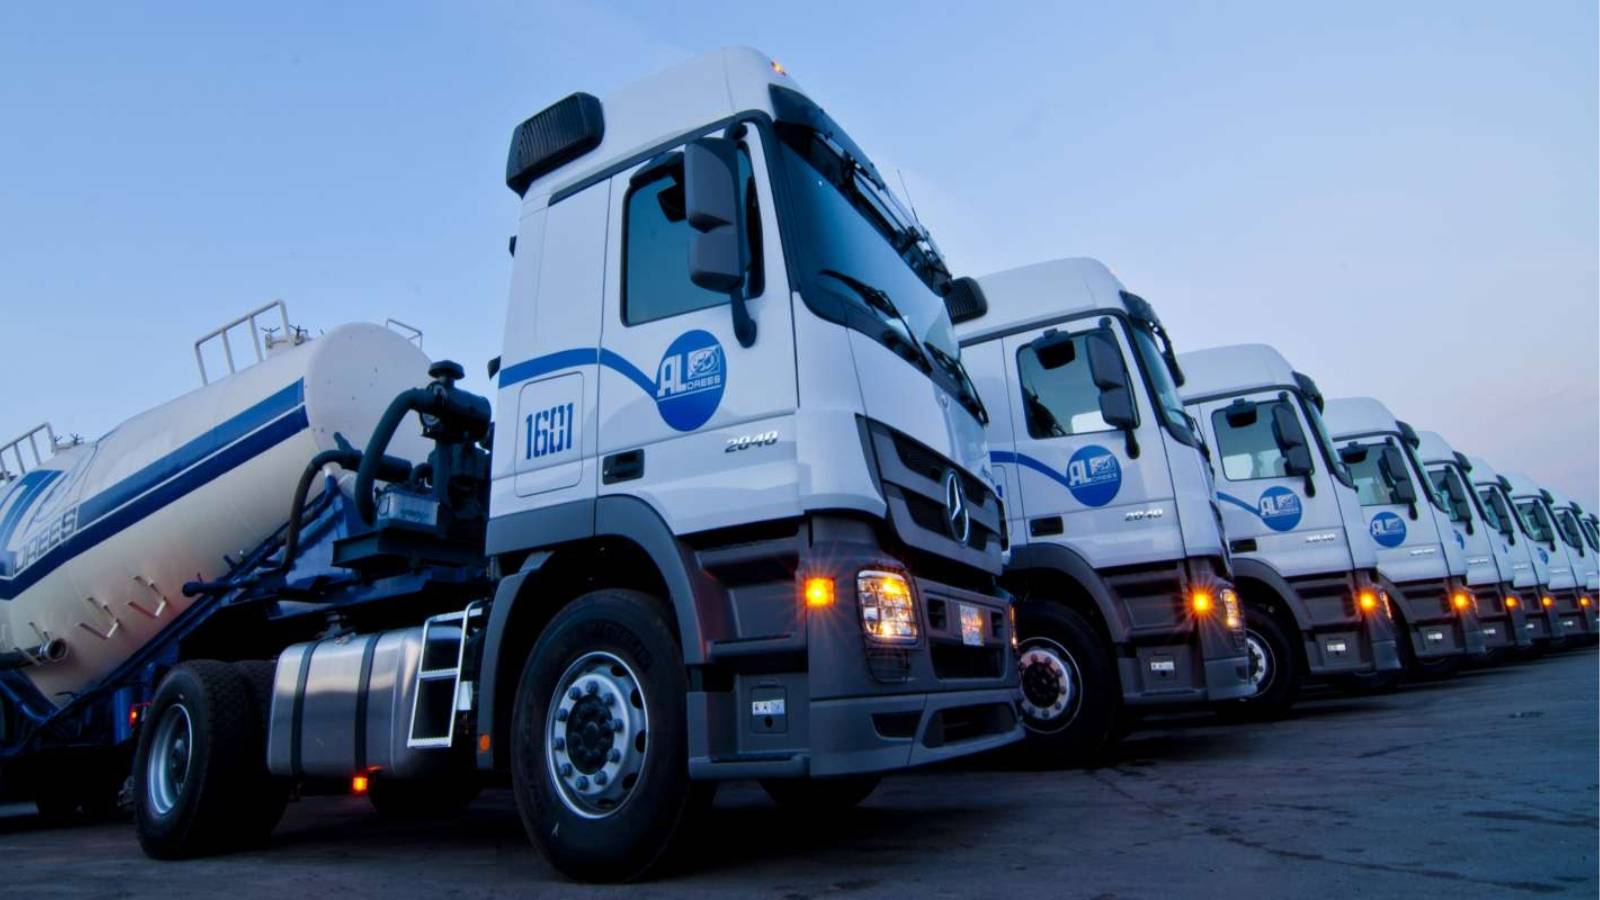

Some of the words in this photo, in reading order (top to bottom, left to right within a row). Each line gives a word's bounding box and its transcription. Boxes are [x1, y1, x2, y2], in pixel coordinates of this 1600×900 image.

[657, 354, 687, 397] AL
[526, 402, 574, 460] 1601
[725, 431, 779, 453] 2040
[1069, 460, 1091, 486] AL
[1260, 496, 1280, 516] AL
